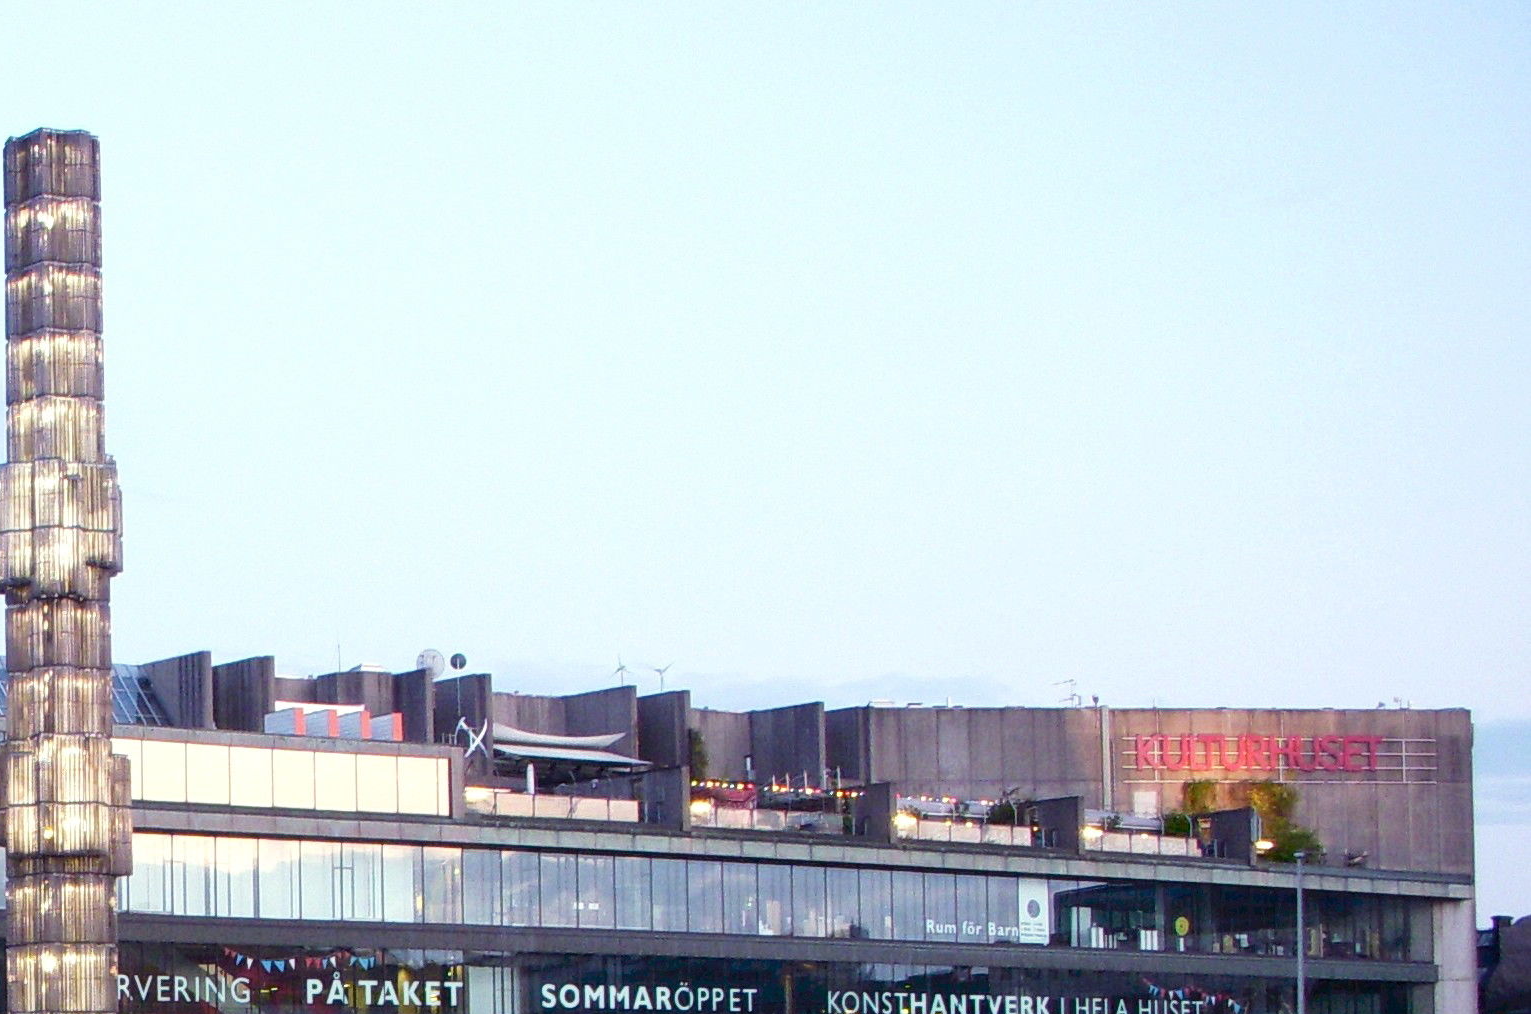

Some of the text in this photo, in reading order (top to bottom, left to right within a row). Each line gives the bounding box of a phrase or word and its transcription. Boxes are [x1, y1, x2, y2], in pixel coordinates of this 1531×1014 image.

[1135, 734, 1383, 771] KULTURHUSET
[926, 919, 956, 934] Rum
[962, 920, 982, 935] för
[988, 922, 1018, 937] Barn
[117, 974, 251, 1004] RVERING
[306, 972, 348, 1006] PÅ
[359, 979, 464, 1007] TAKET
[541, 982, 758, 1012] SOMMARÖPPET
